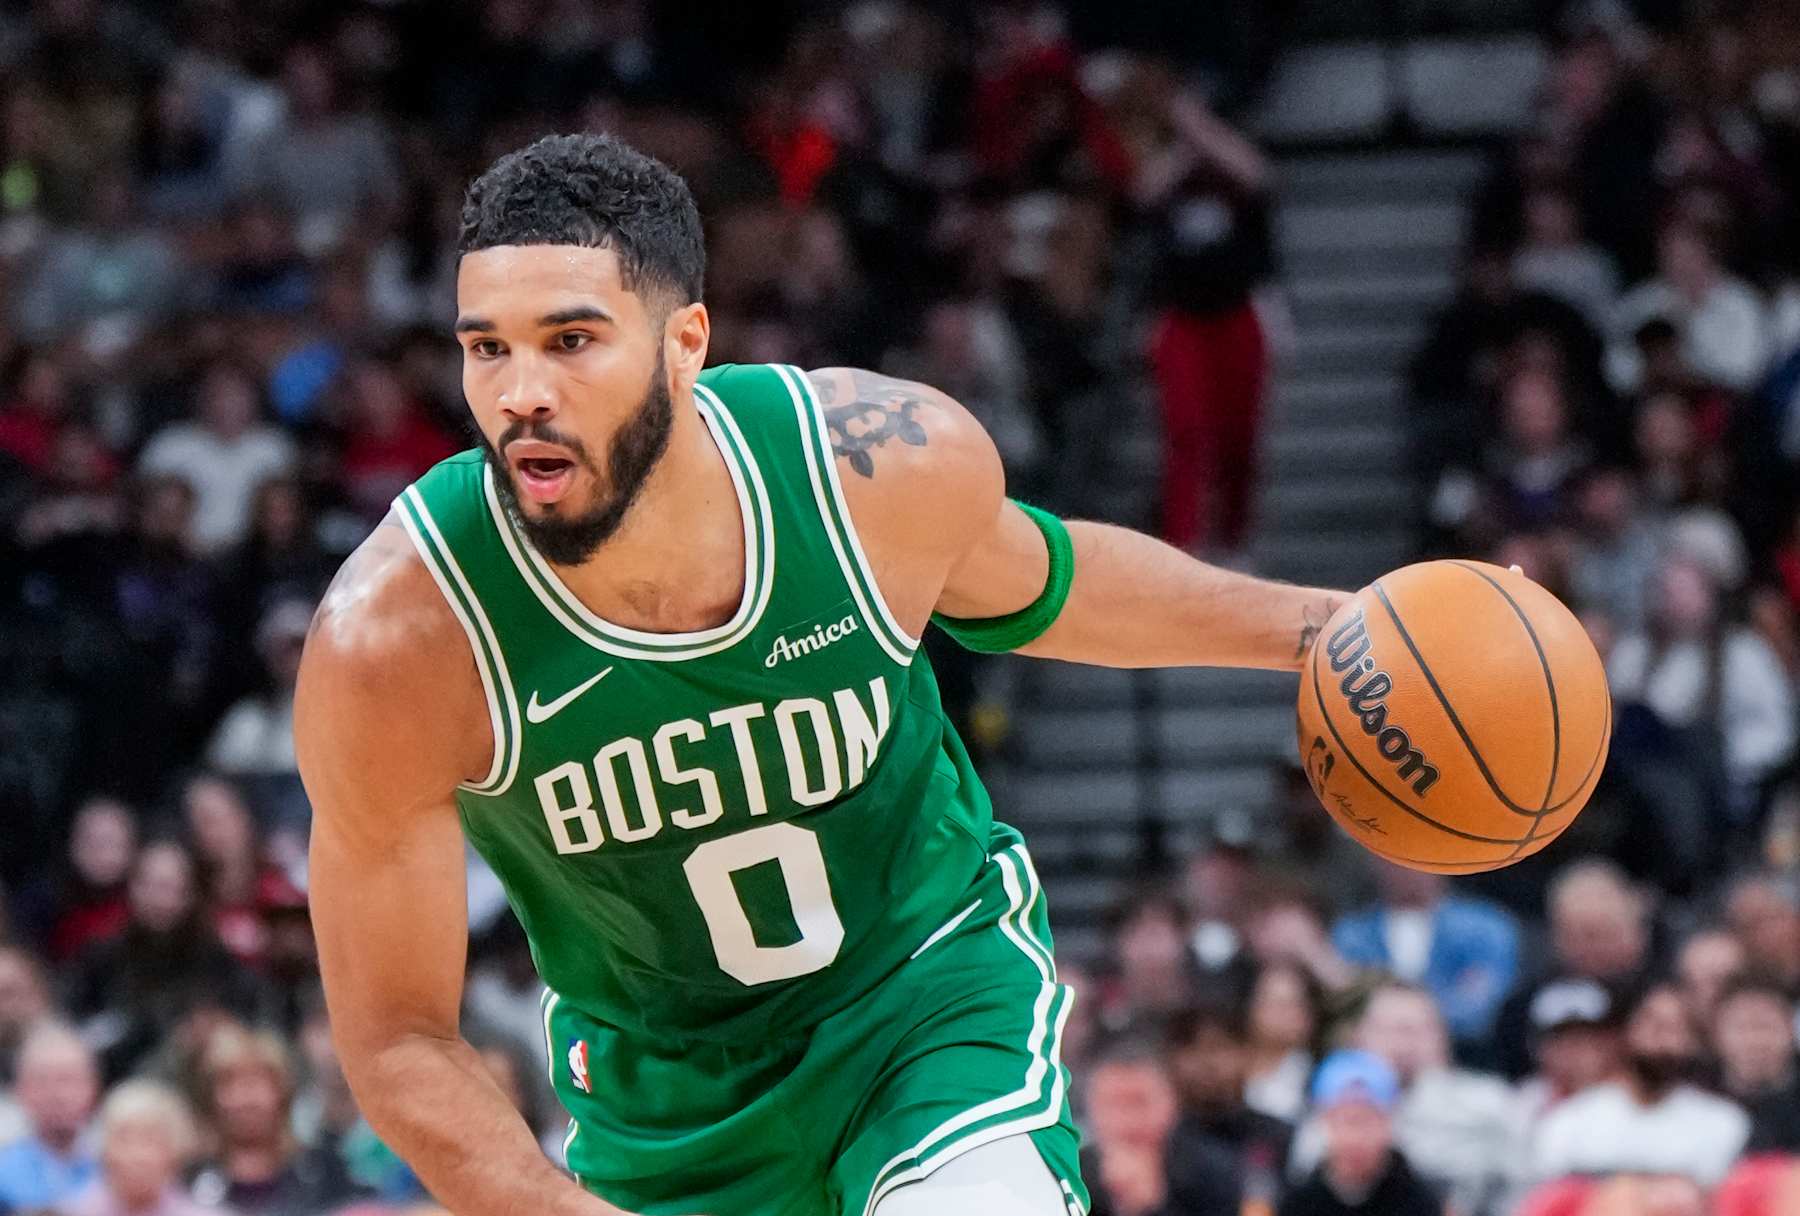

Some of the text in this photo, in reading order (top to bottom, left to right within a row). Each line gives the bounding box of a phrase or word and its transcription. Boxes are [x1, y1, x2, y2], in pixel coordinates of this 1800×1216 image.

[764, 614, 859, 669] Amica
[1326, 607, 1441, 799] Wilson
[533, 675, 890, 856] BOSTON
[682, 821, 846, 987] 0
